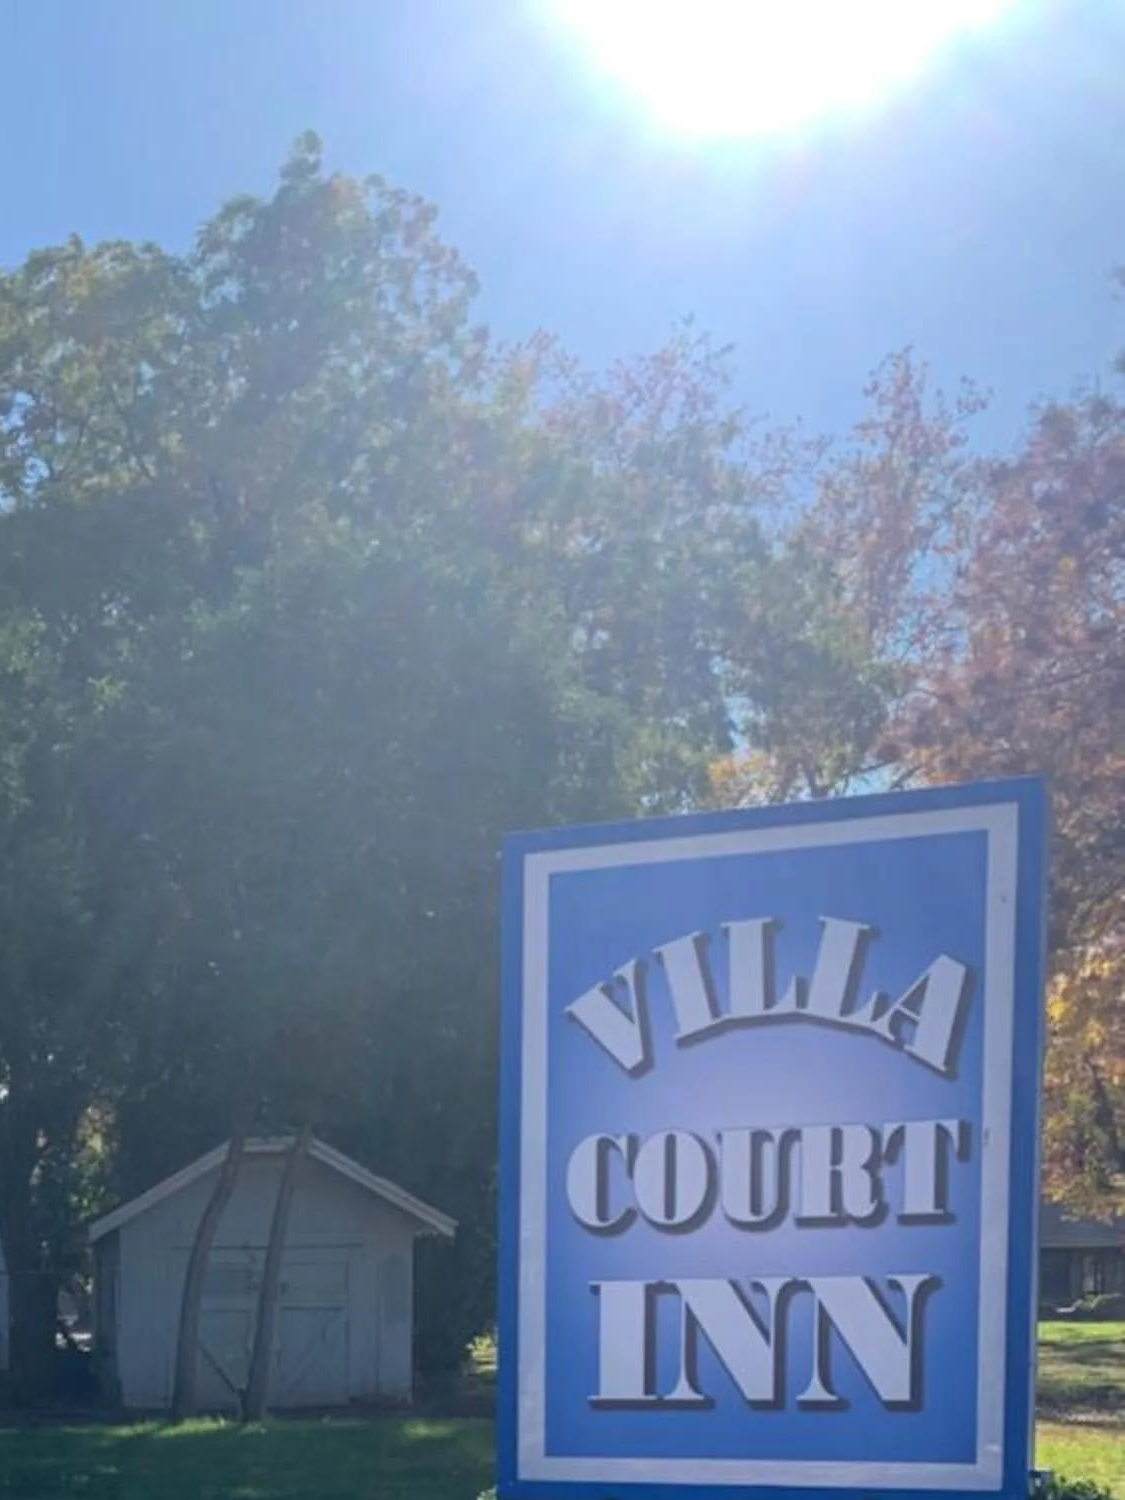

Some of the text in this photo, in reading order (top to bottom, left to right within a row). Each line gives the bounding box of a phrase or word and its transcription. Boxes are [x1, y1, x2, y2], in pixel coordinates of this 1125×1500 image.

[564, 915, 973, 1078] VILLA
[566, 1118, 970, 1233] COURT
[587, 1273, 942, 1411] INN
